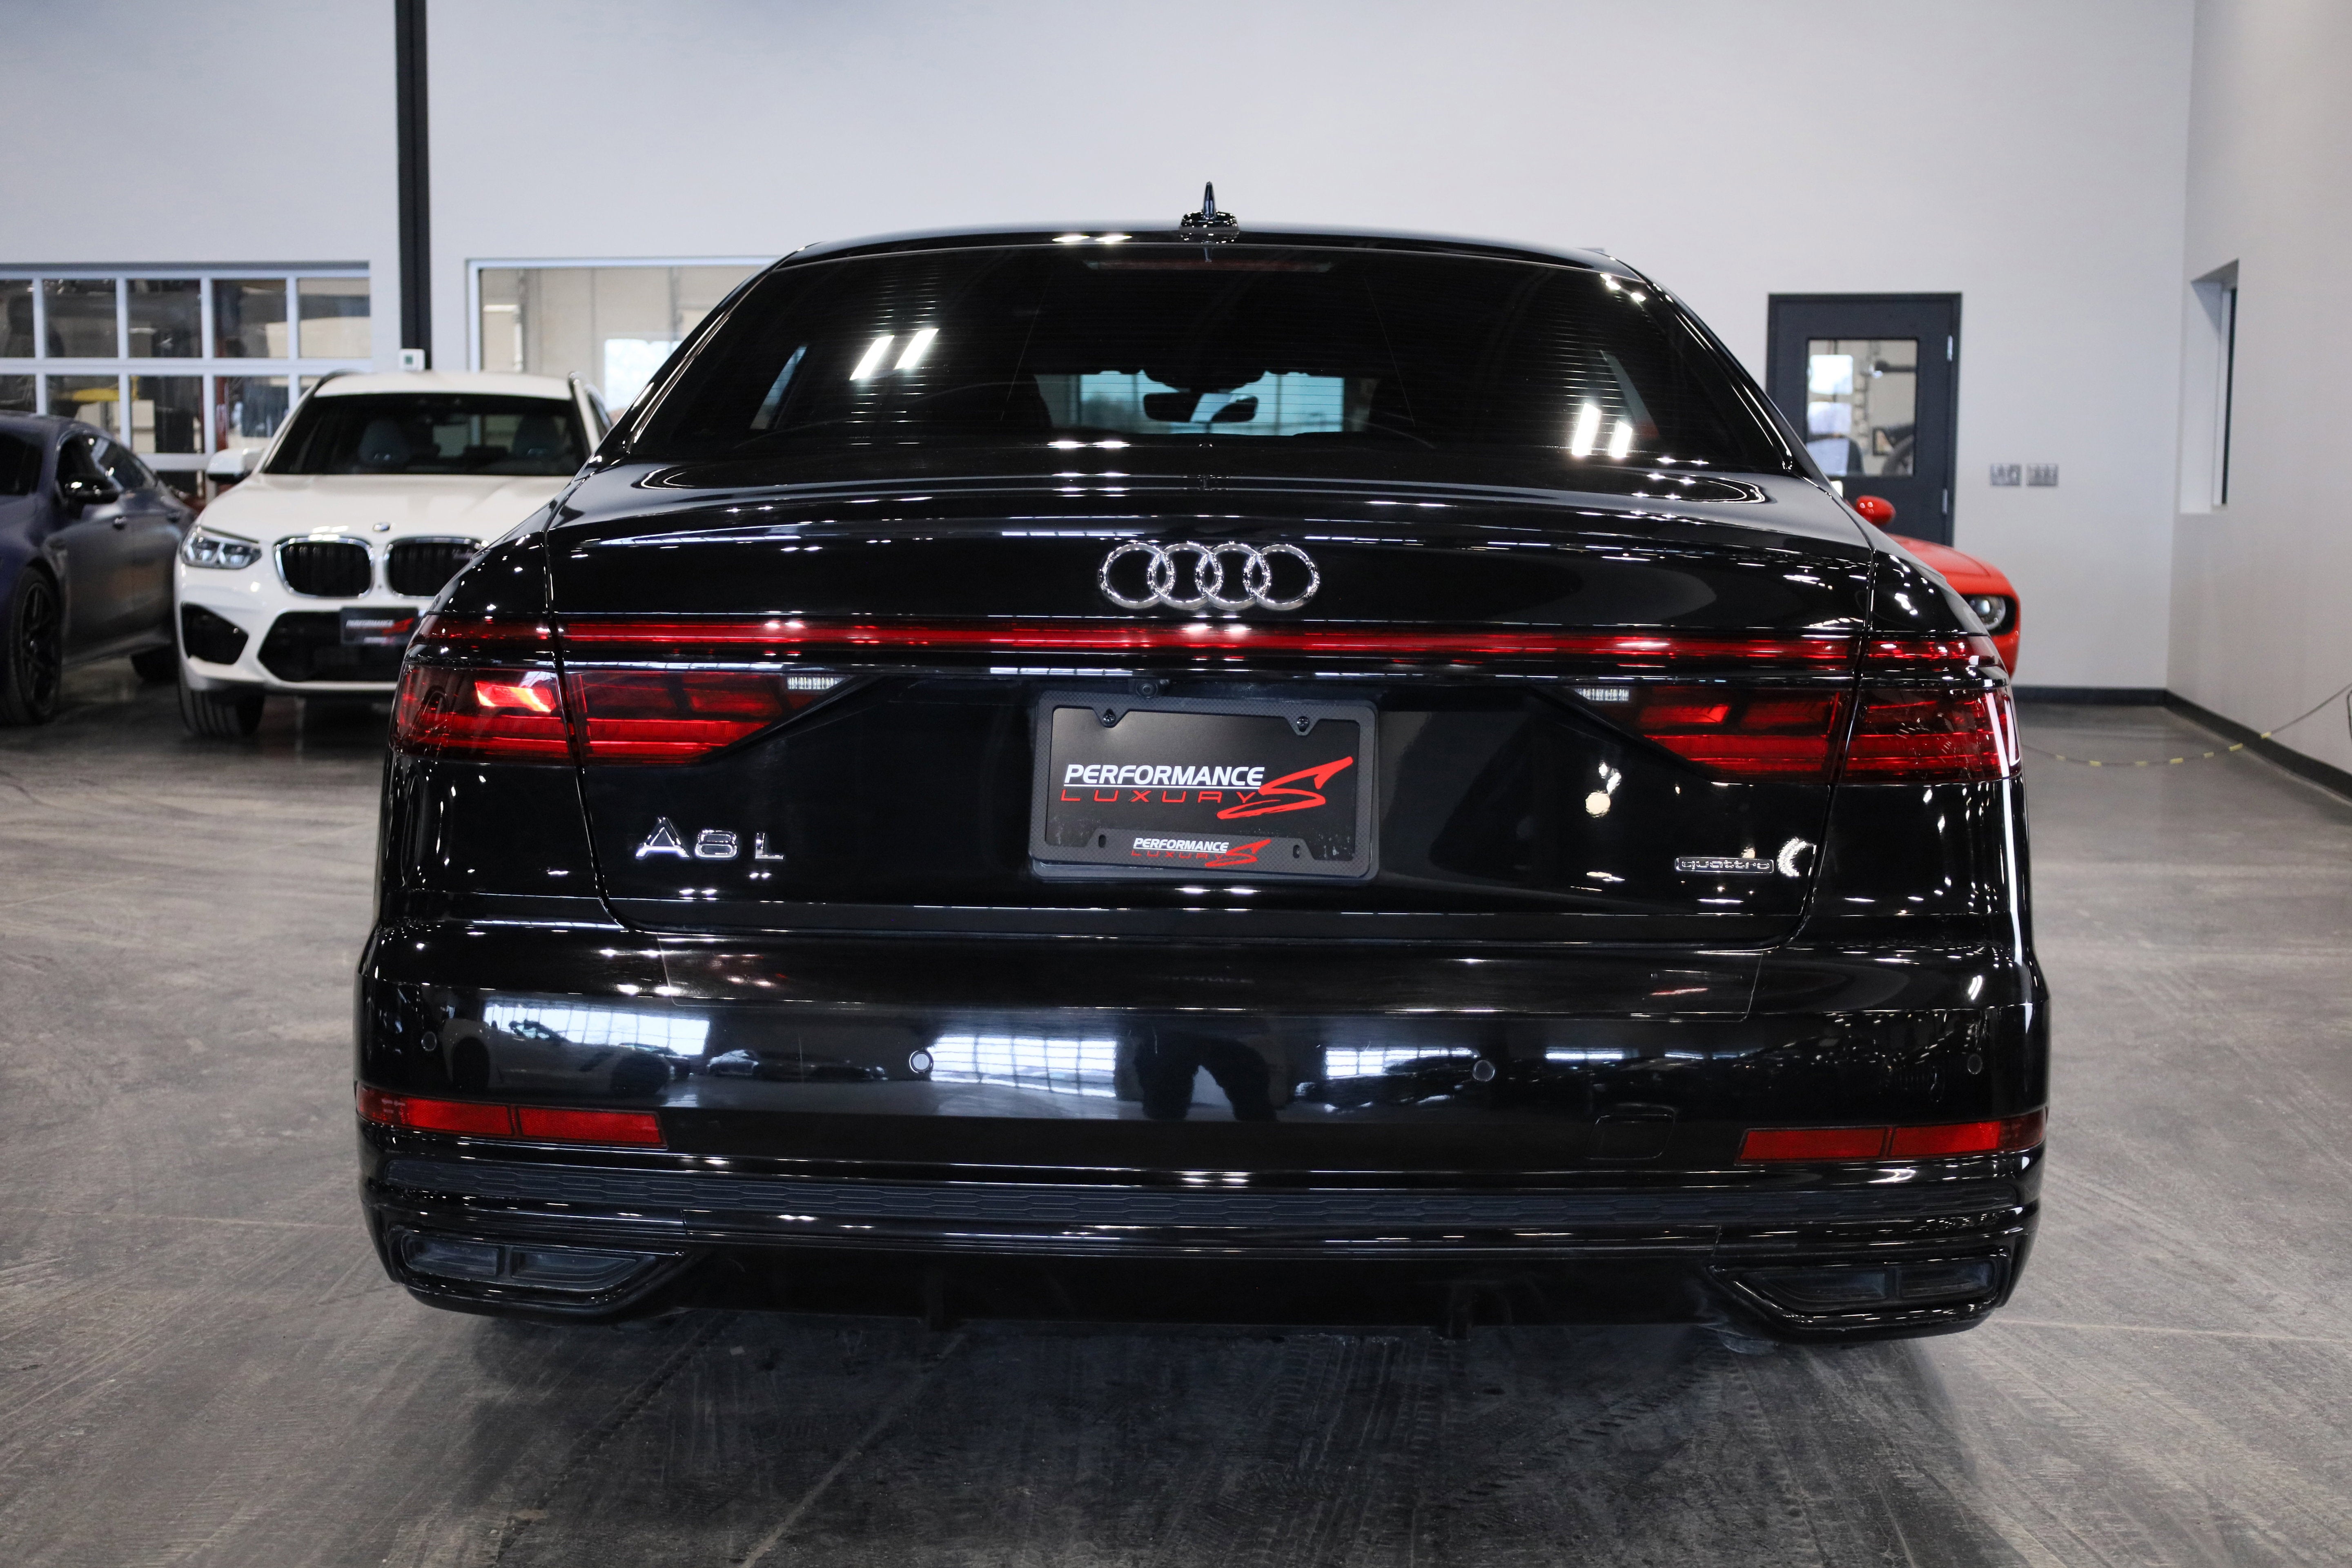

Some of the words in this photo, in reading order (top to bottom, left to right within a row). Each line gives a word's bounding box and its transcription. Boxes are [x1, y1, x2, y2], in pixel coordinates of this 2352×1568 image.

[1064, 764, 1265, 786] PERFORMANCE
[1060, 789, 1256, 803] LUXURY
[1134, 837, 1229, 851] PERFORMANCE
[1681, 860, 1770, 871] quattro
